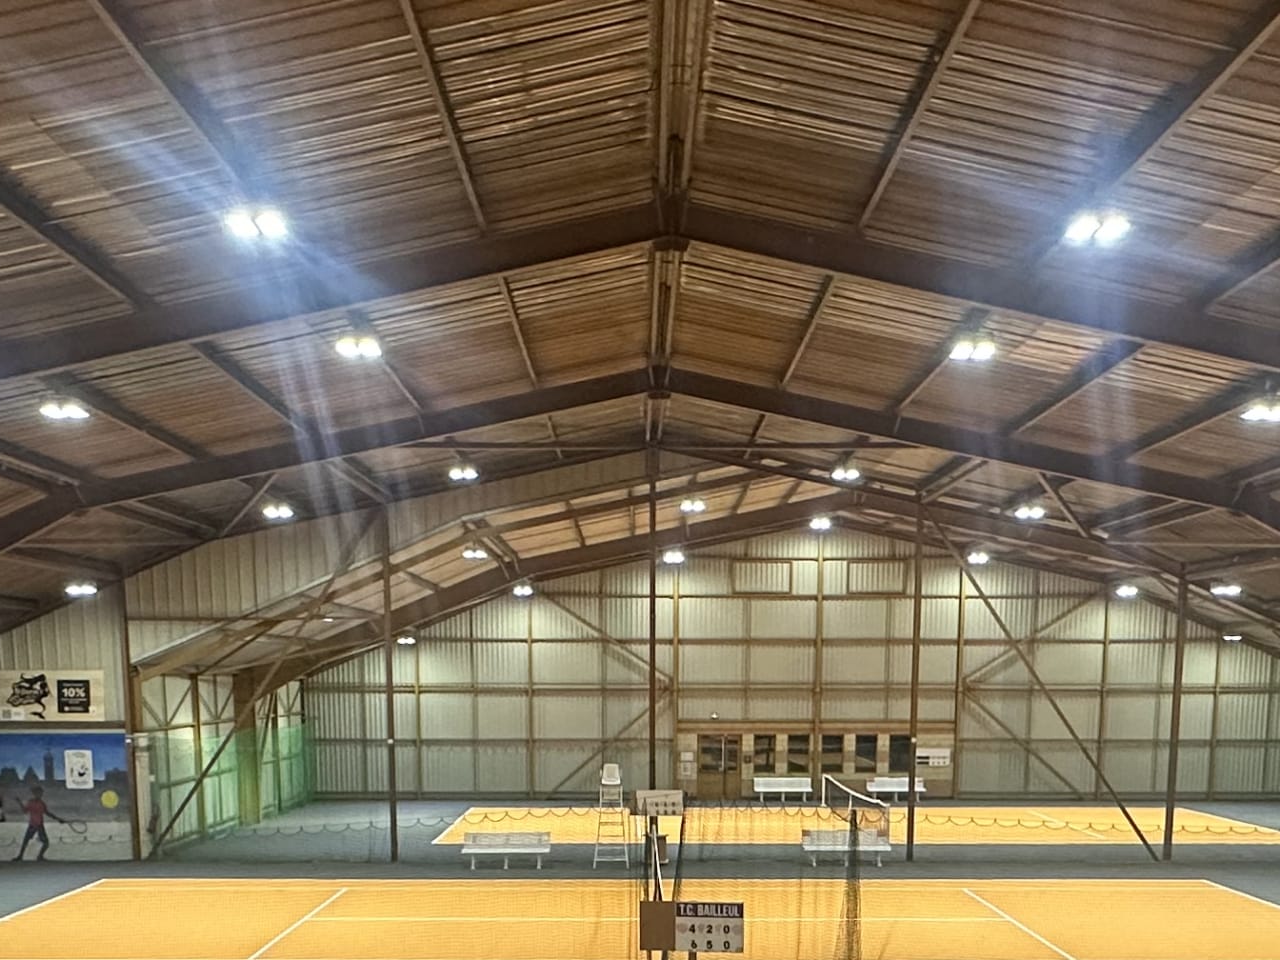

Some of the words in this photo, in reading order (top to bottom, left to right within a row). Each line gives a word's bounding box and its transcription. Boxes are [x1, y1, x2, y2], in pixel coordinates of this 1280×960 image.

[62, 687, 86, 697] 10%
[697, 904, 740, 916] BAILLEUL
[689, 924, 696, 934] 4
[706, 924, 713, 934] 2
[723, 924, 730, 934] 0
[691, 940, 698, 950] 6
[706, 940, 713, 950] 5
[723, 941, 730, 950] 0
